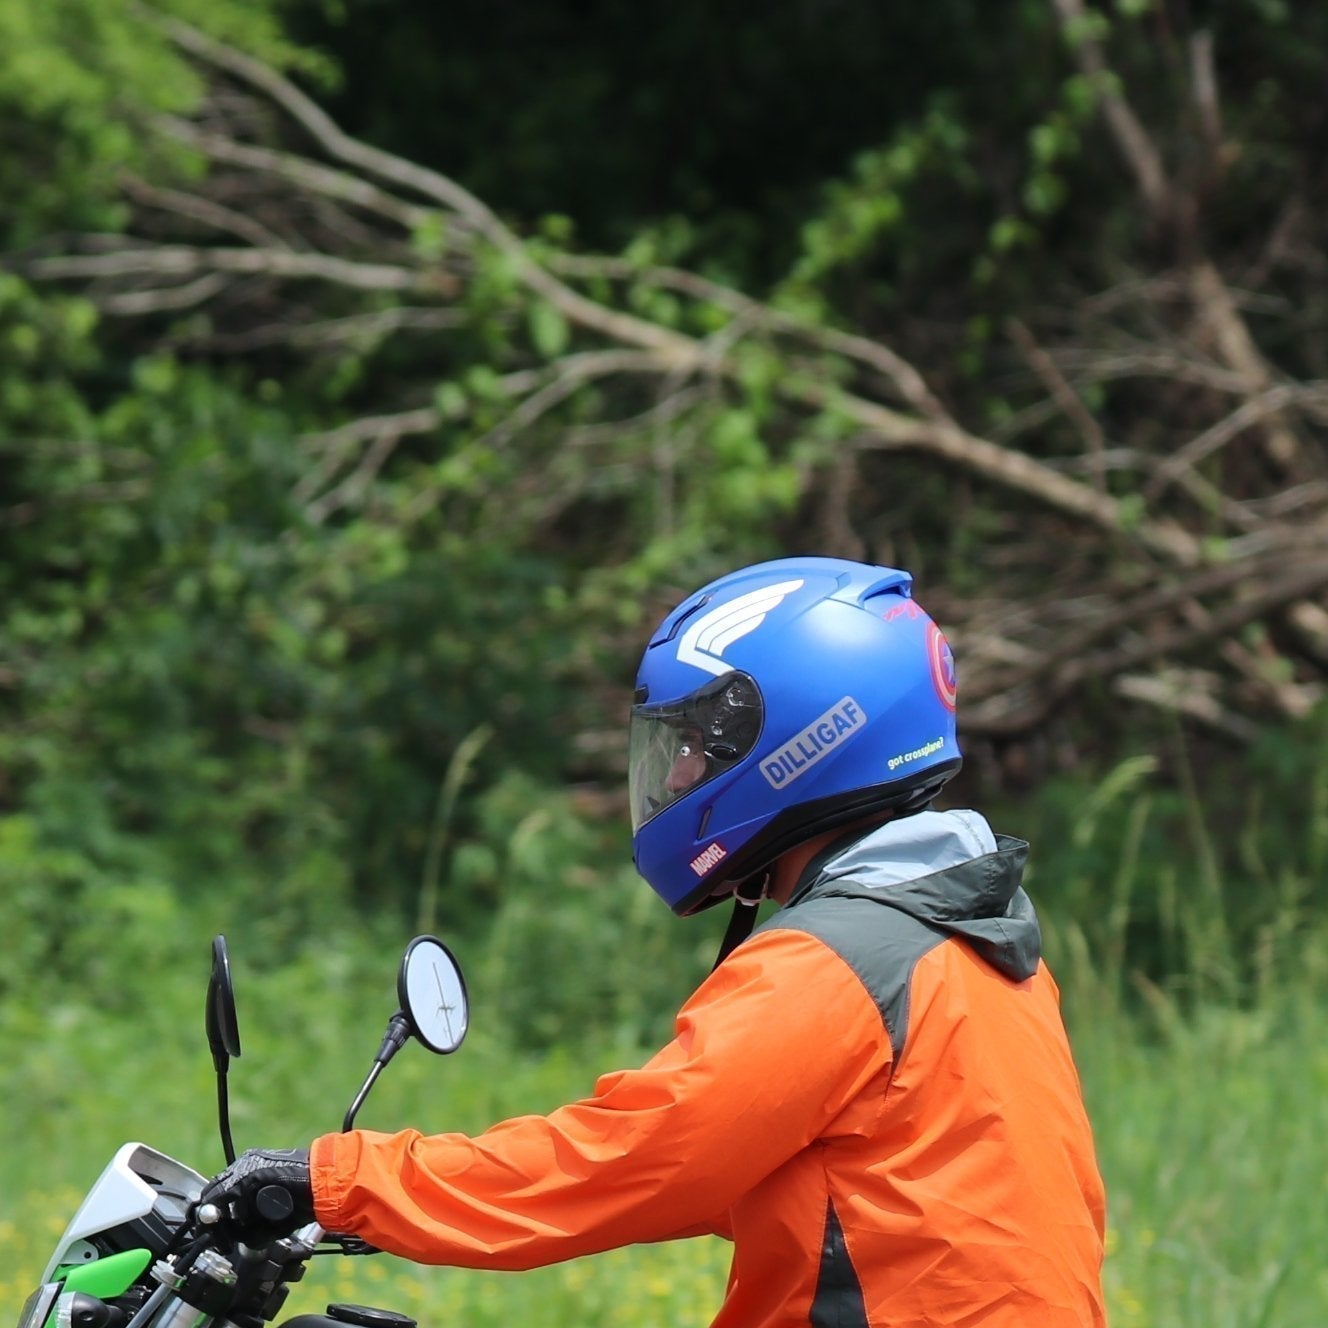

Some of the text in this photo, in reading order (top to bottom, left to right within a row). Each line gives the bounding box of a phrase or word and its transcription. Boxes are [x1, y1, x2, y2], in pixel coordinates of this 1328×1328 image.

[765, 701, 858, 784] DILLIGAF
[887, 755, 904, 770] got
[690, 843, 727, 877] MARVEL
